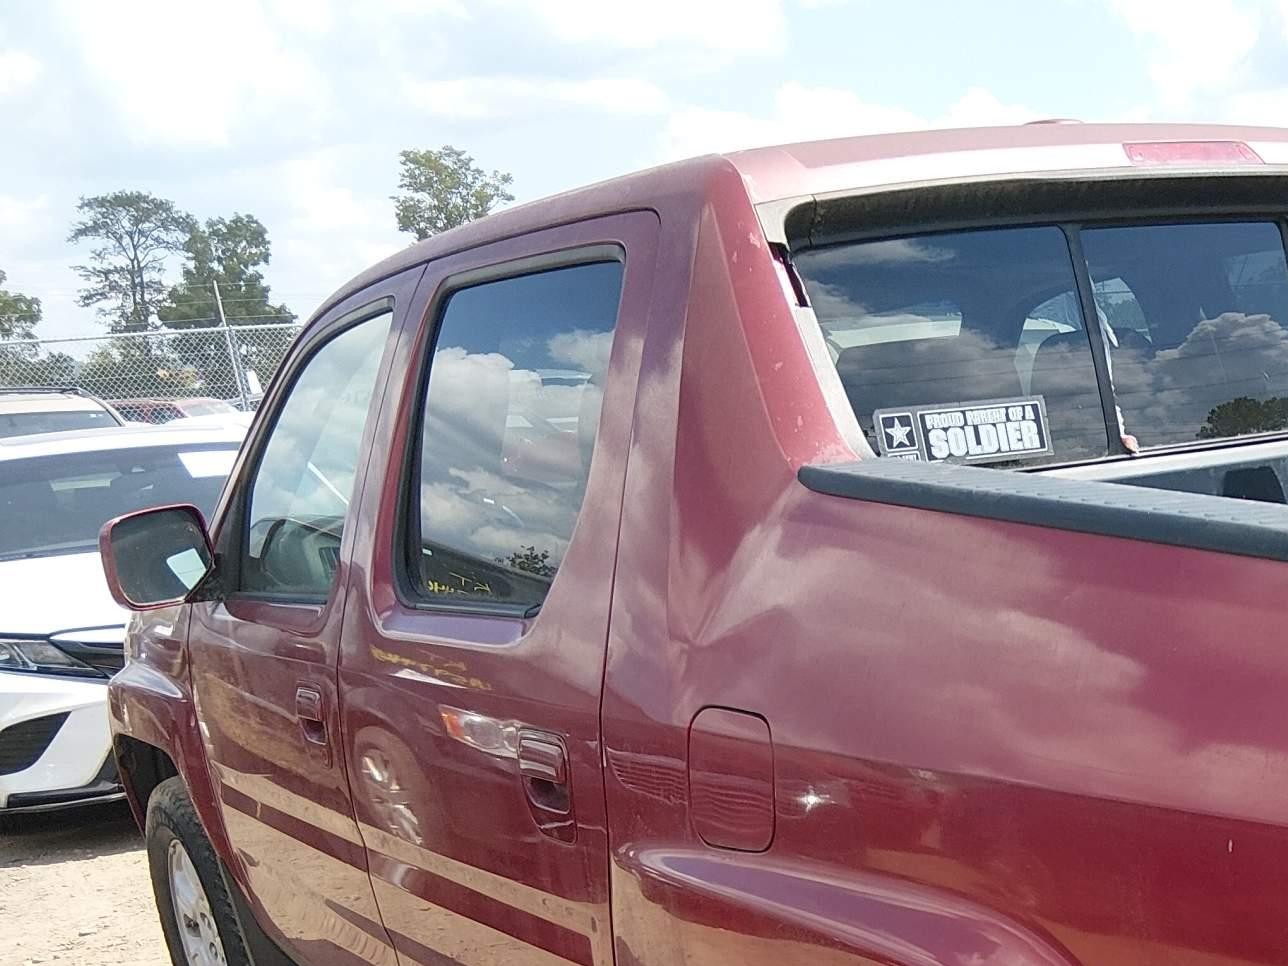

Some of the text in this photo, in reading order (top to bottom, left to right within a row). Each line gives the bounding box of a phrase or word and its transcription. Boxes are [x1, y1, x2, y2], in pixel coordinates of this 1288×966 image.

[925, 405, 1036, 430] PROUD PARENT OF A
[928, 420, 1041, 459] SOLDIER
